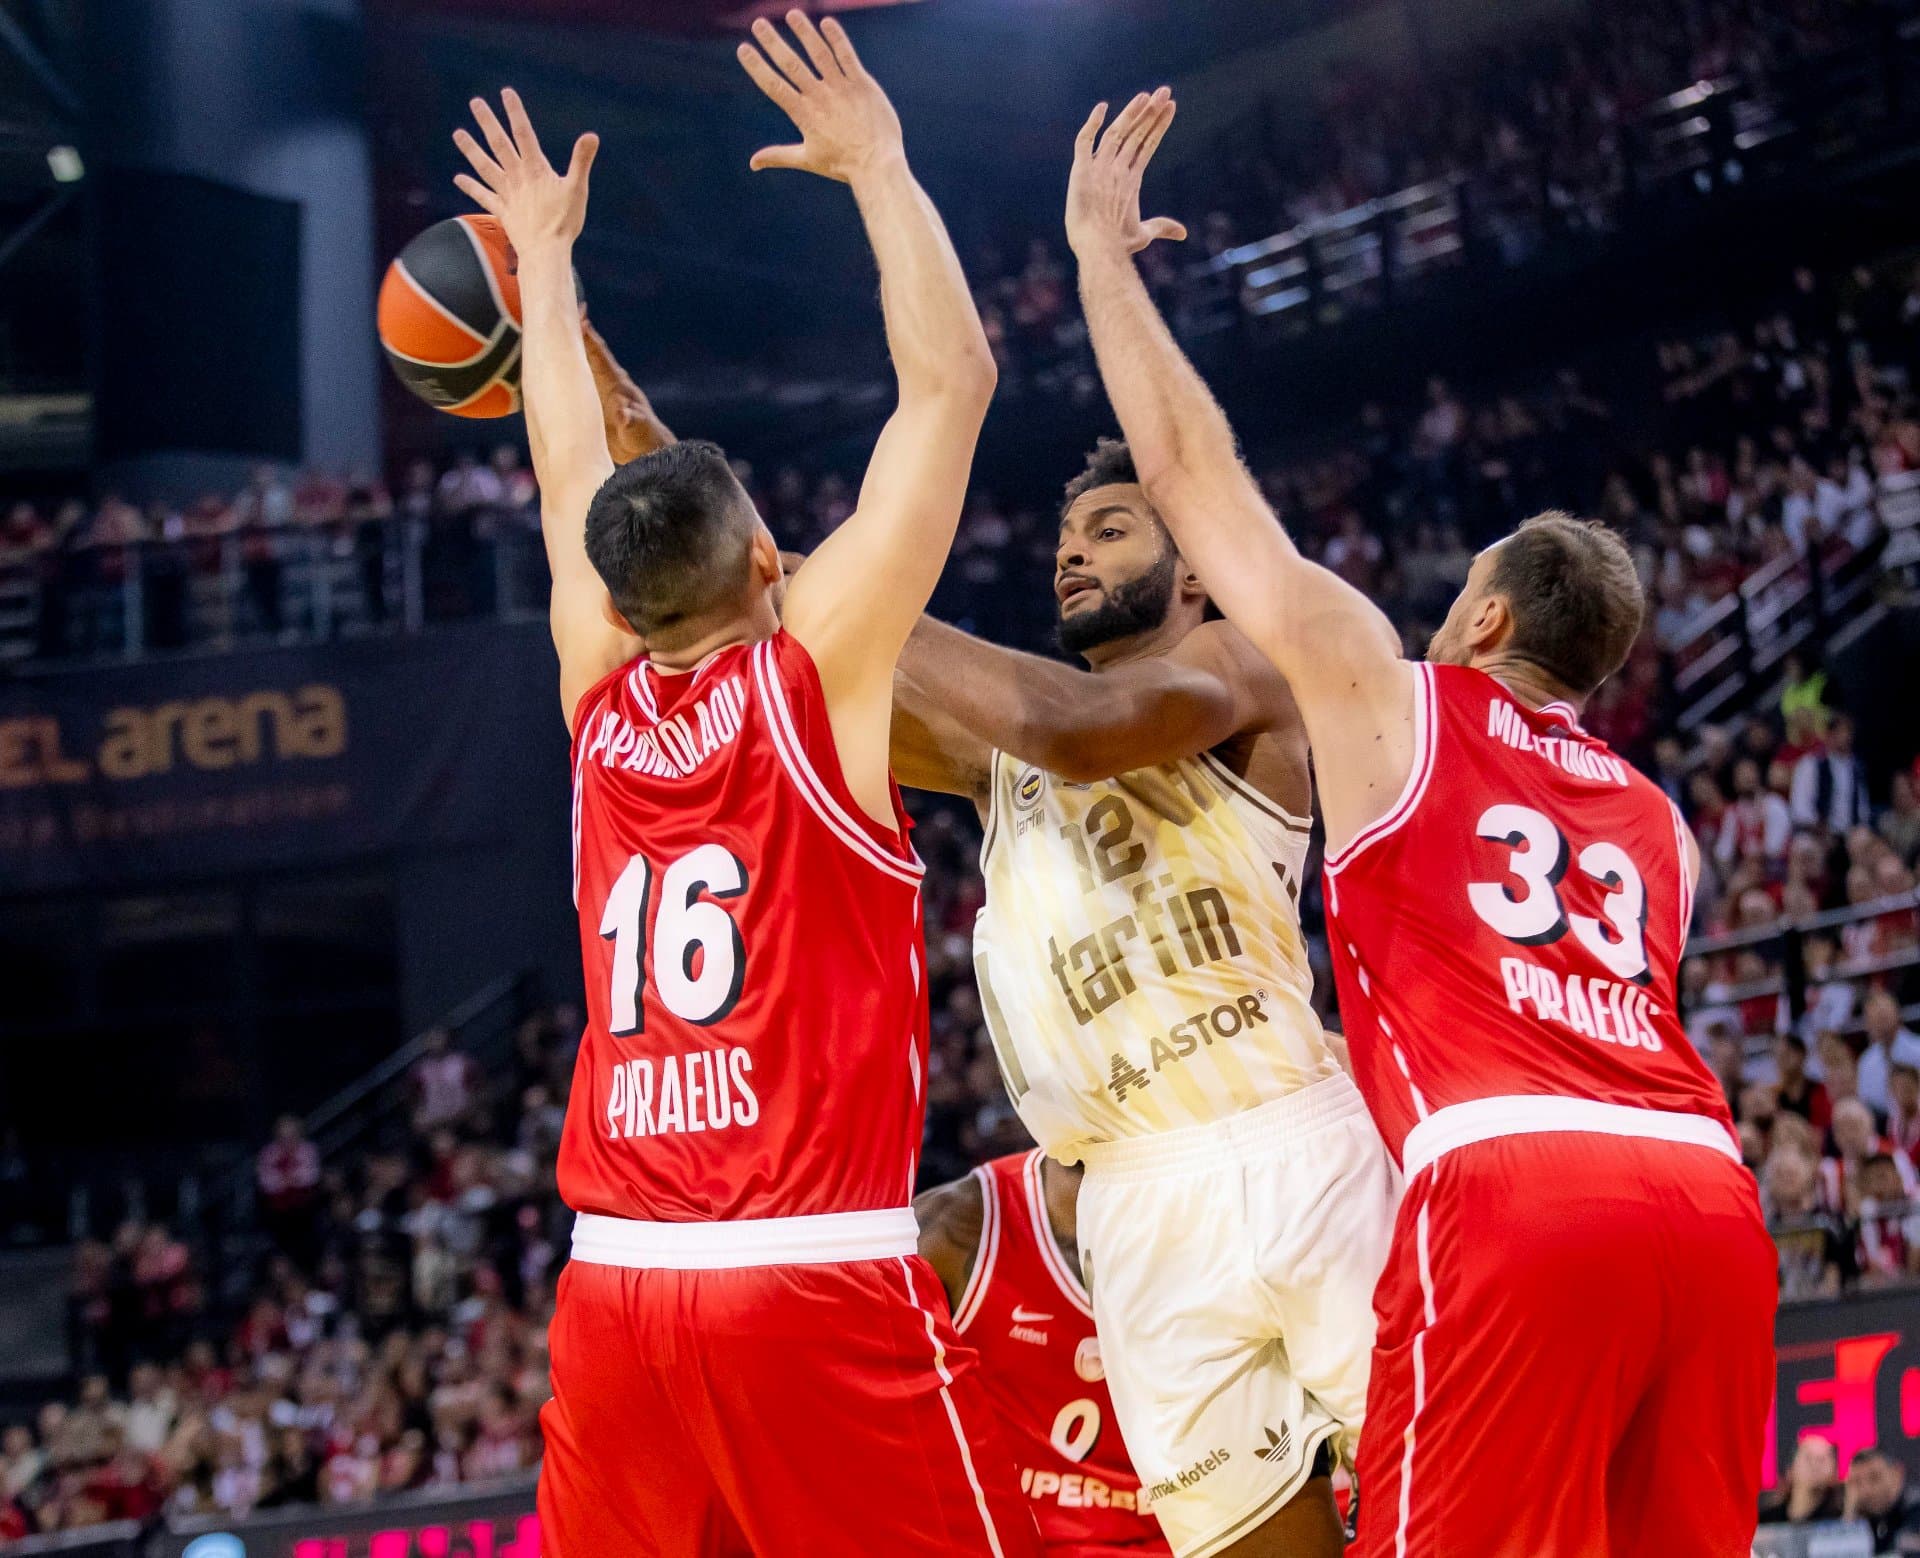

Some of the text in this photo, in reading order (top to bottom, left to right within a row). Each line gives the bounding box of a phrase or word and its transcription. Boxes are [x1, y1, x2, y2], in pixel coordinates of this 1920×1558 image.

[100, 683, 347, 779] arena
[1060, 794, 1147, 895] 12
[600, 843, 749, 1038] 16
[1467, 804, 1652, 986] 33
[1048, 873, 1243, 1027] tarfin
[1500, 957, 1663, 1052] PIRAEUS
[607, 1046, 760, 1139] PIRAEUS
[1050, 1398, 1102, 1463] 0
[1176, 1448, 1231, 1489] Hotels
